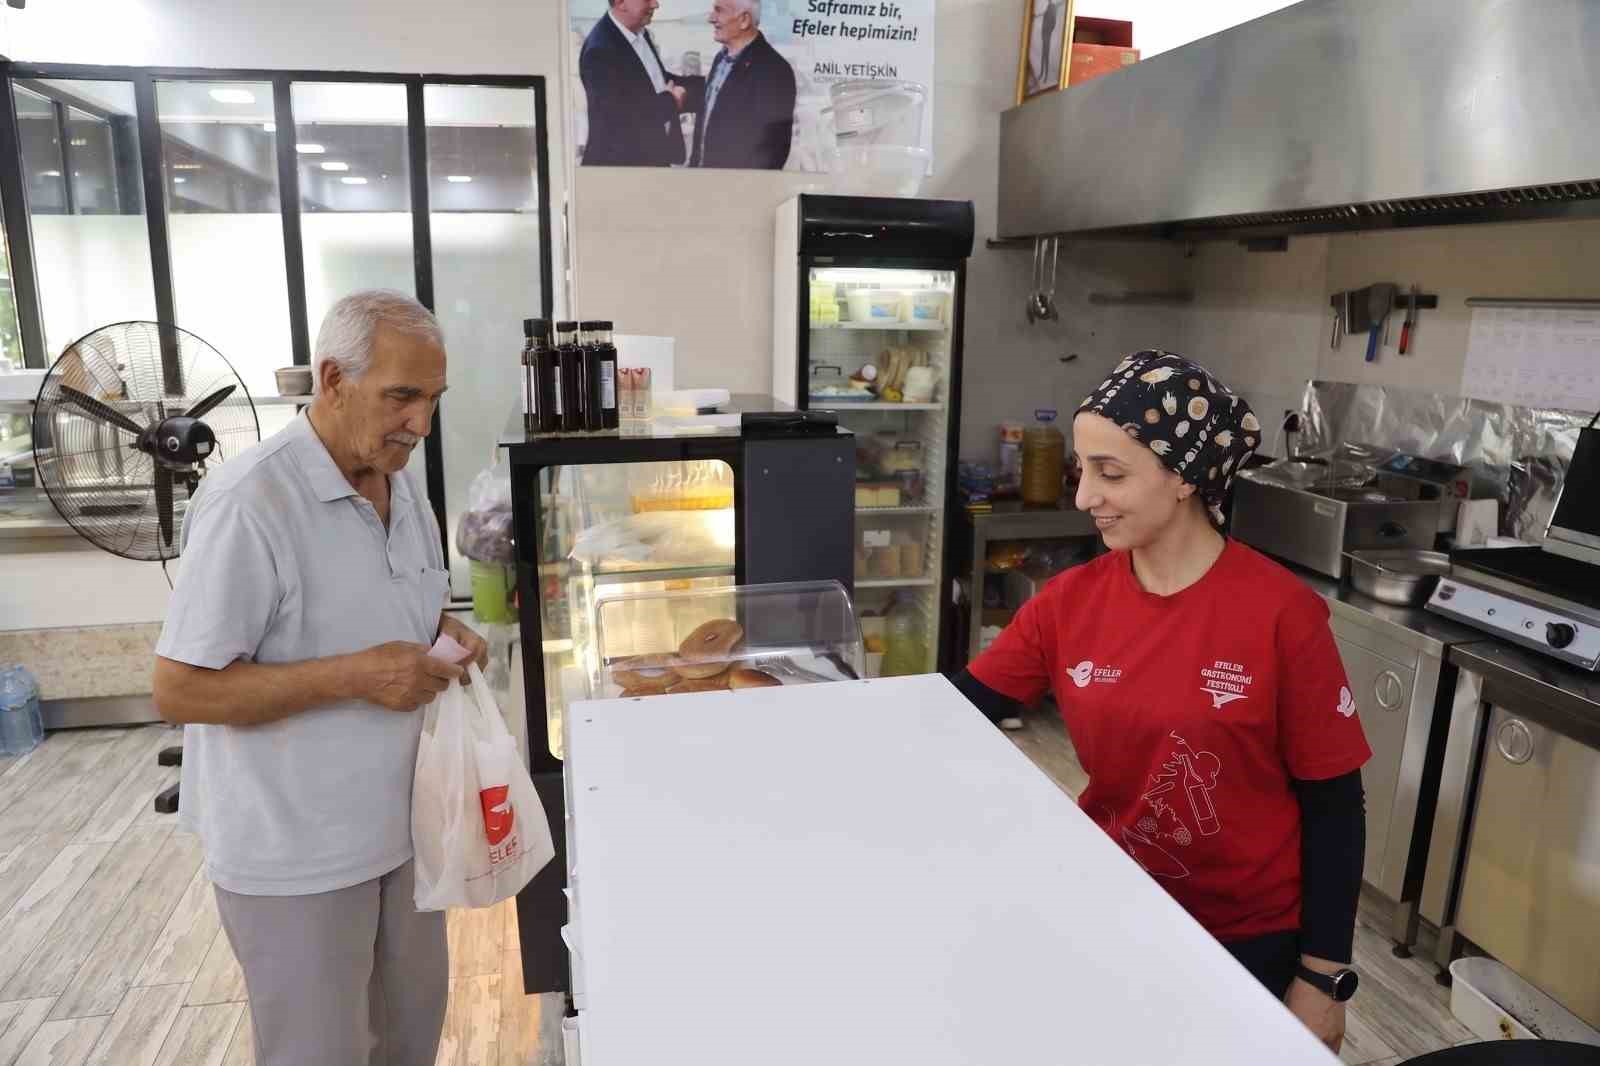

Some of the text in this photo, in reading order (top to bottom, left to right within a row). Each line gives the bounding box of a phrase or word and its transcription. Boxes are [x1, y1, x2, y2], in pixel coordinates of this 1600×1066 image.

[808, 0, 903, 20] Saframız bir,
[792, 19, 918, 41] Efeler hepimizin!
